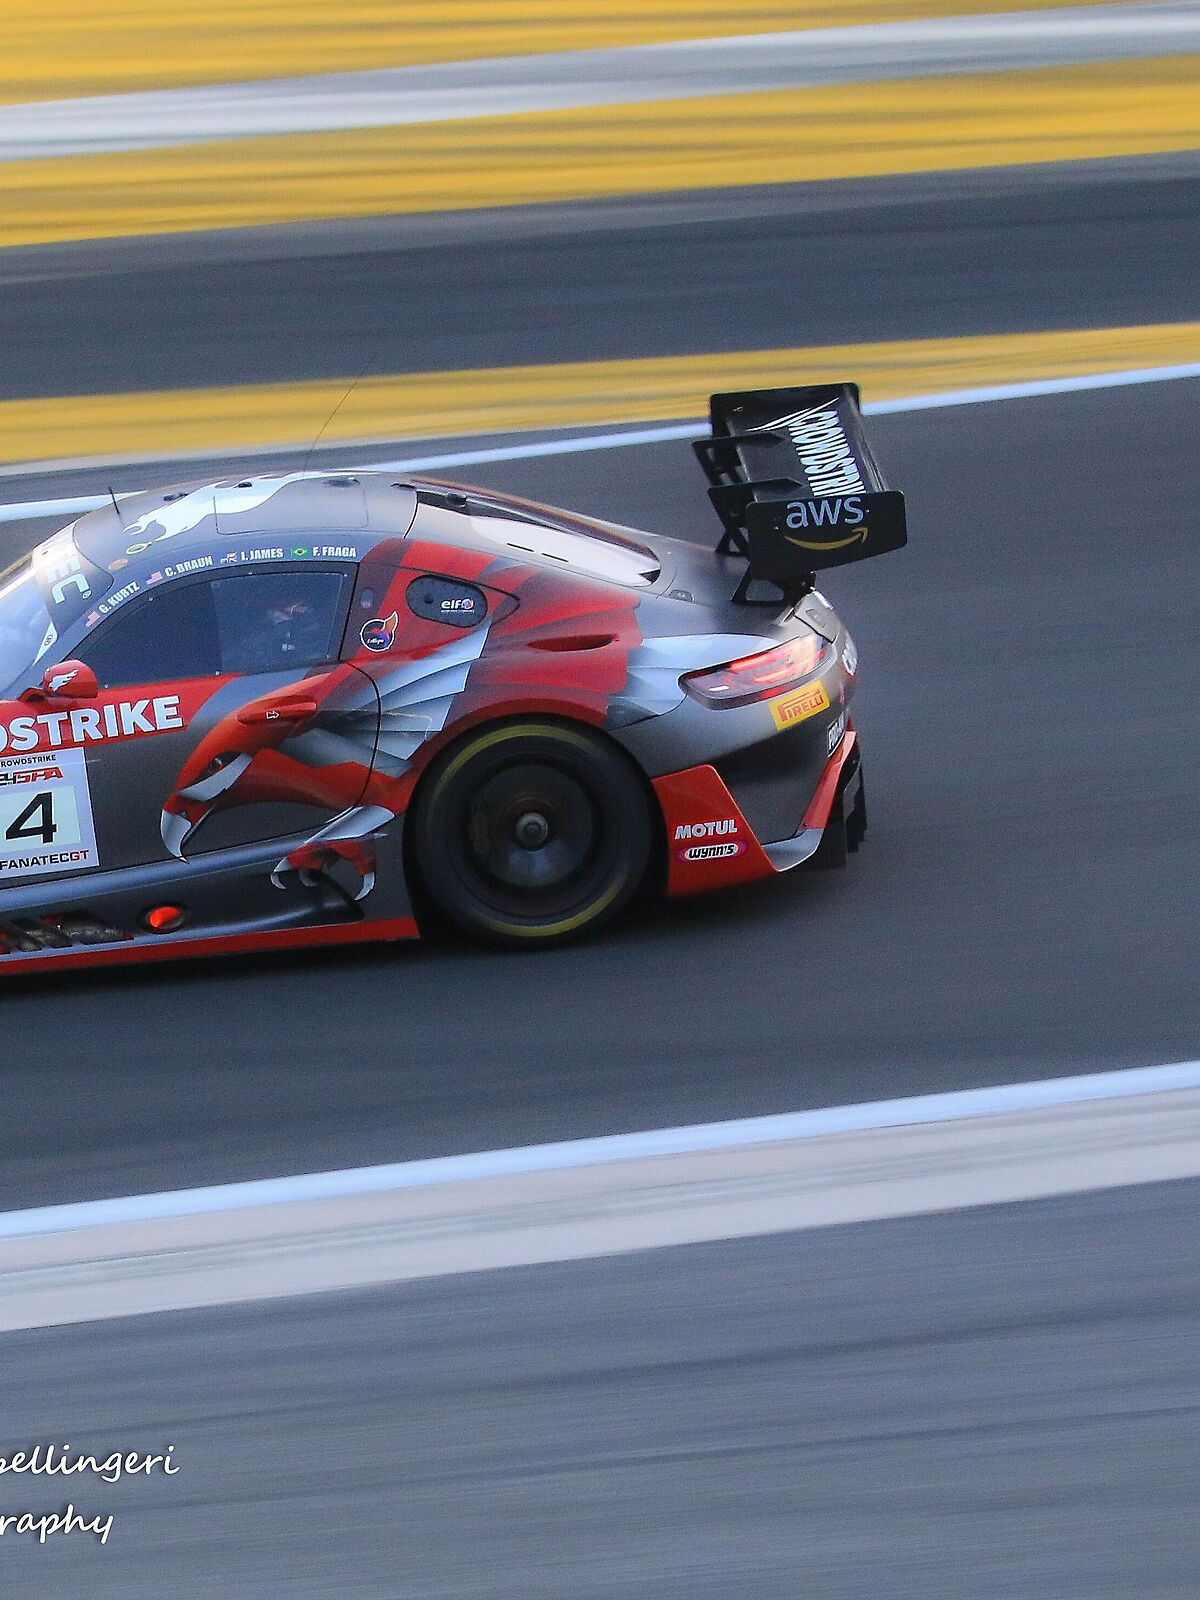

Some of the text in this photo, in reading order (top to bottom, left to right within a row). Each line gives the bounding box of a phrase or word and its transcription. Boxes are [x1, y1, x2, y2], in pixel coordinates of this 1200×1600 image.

[788, 410, 867, 497] CROWDSTRIK
[786, 496, 864, 529] aws
[250, 548, 284, 560] JAMES
[322, 546, 357, 558] FRAGA
[164, 555, 214, 577] C. BRAUN
[98, 581, 140, 614] G. KURTZ
[440, 599, 461, 610] elf
[777, 688, 825, 722] PIRELLI
[5, 791, 57, 844] 4
[674, 819, 738, 840] MOTUL
